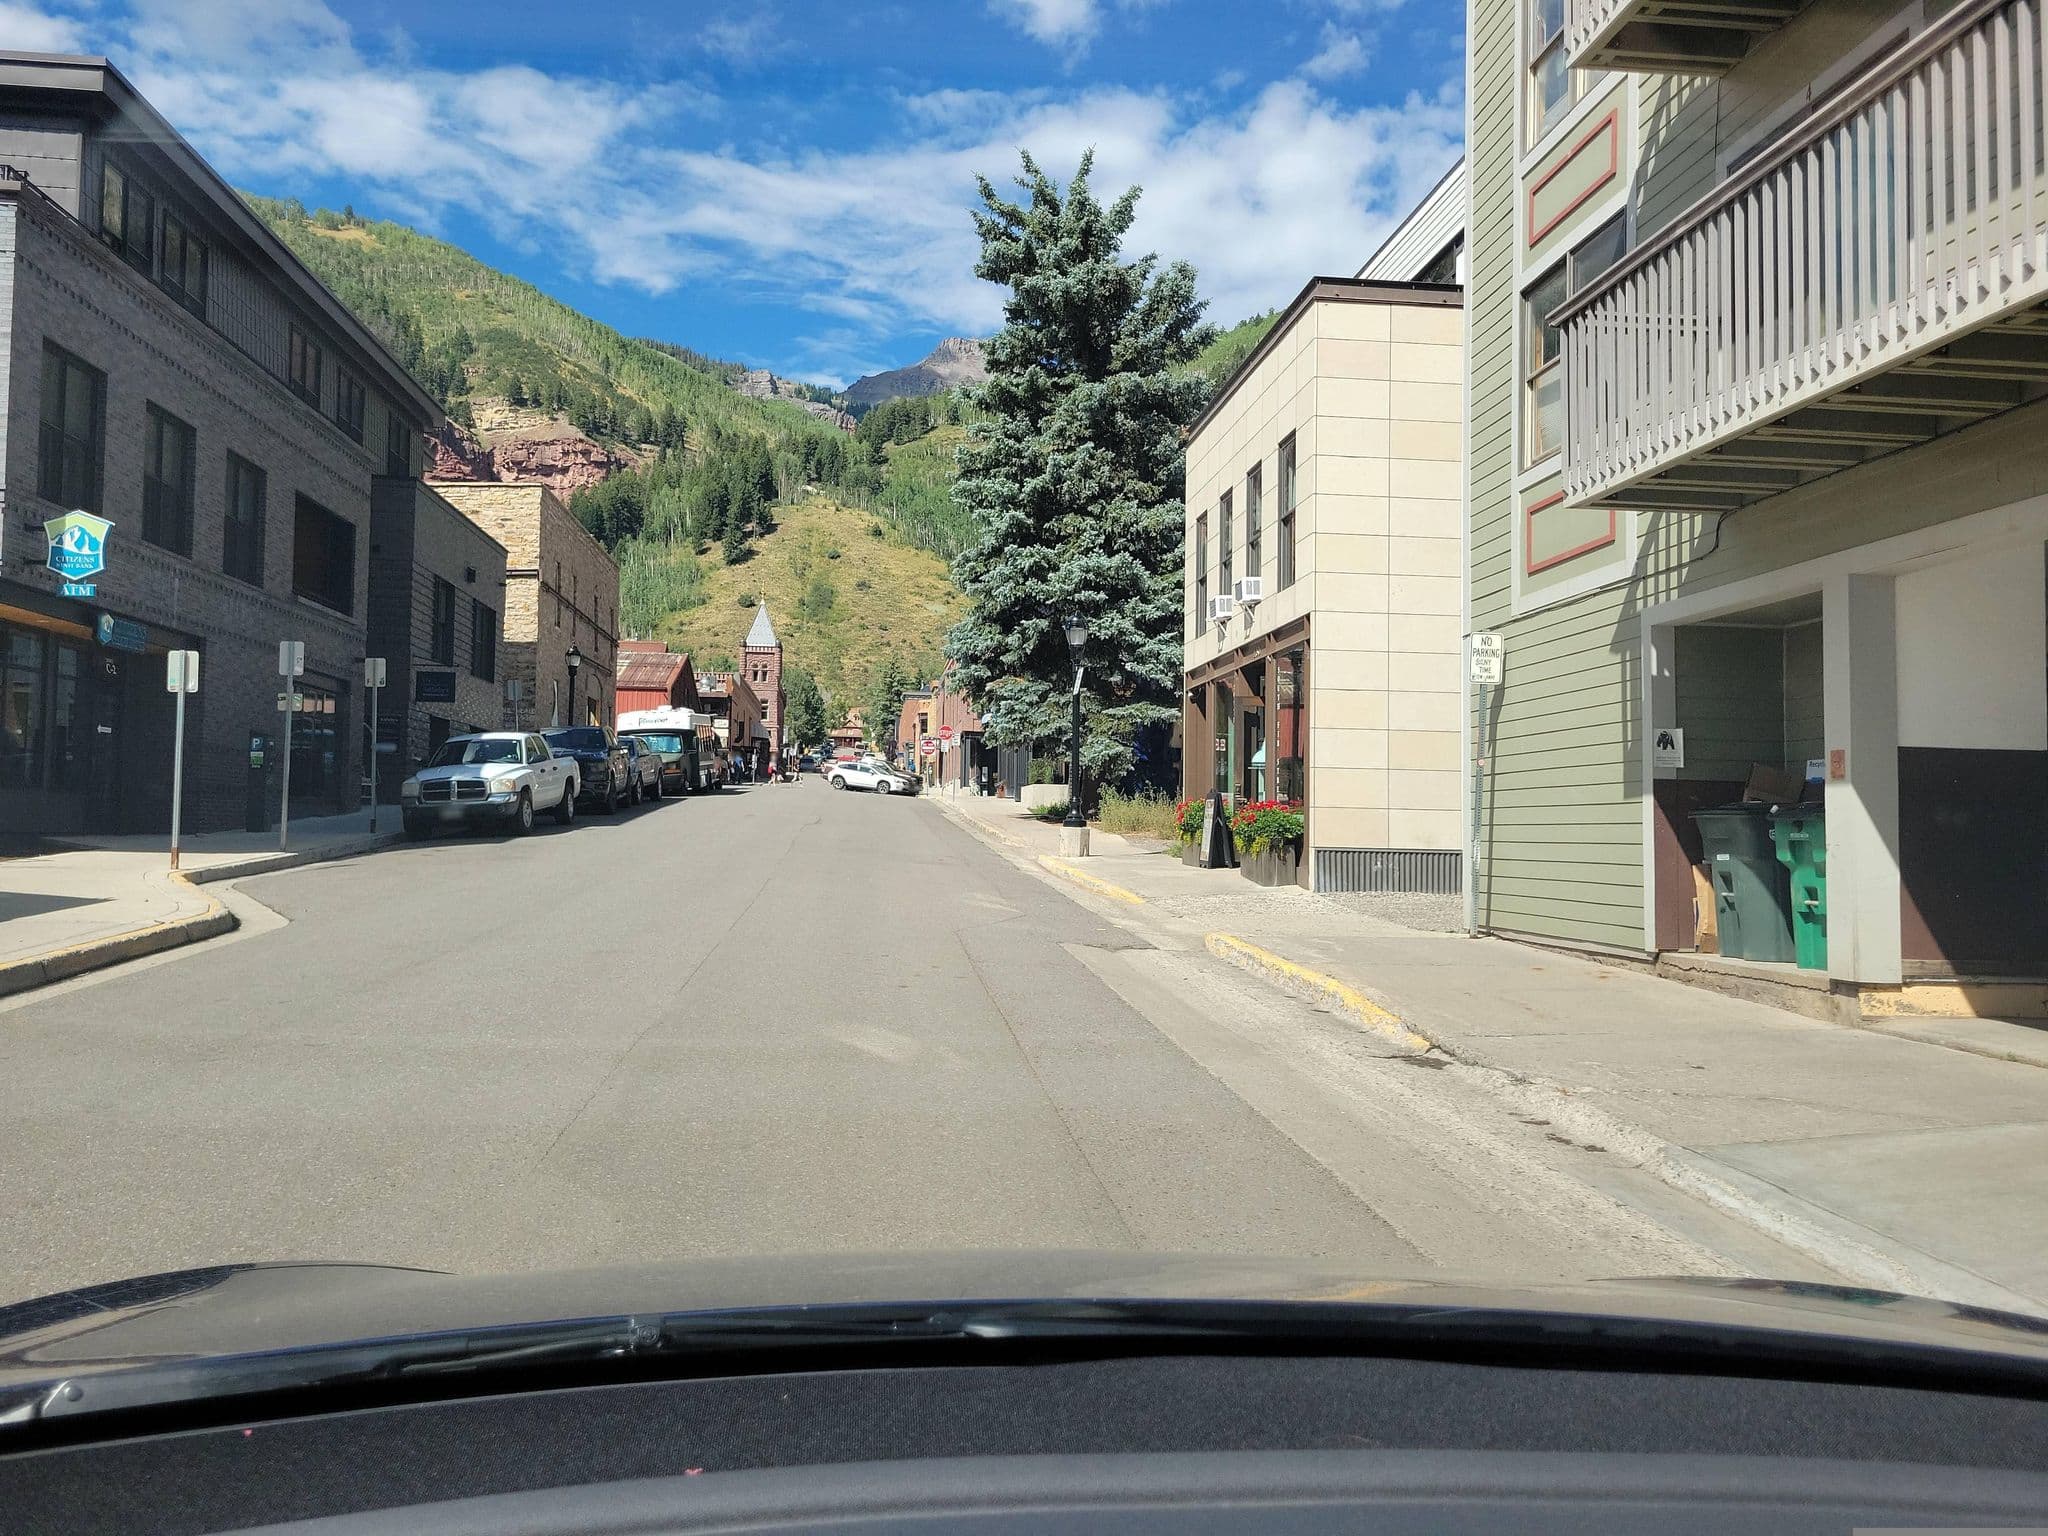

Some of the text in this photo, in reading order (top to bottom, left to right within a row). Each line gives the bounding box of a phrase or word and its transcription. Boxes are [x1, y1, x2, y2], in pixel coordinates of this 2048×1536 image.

[55, 555, 95, 563] CITIZENS
[60, 586, 91, 596] ATM
[1481, 636, 1493, 646] NO
[1473, 648, 1500, 658] PARKING
[253, 737, 261, 748] P
